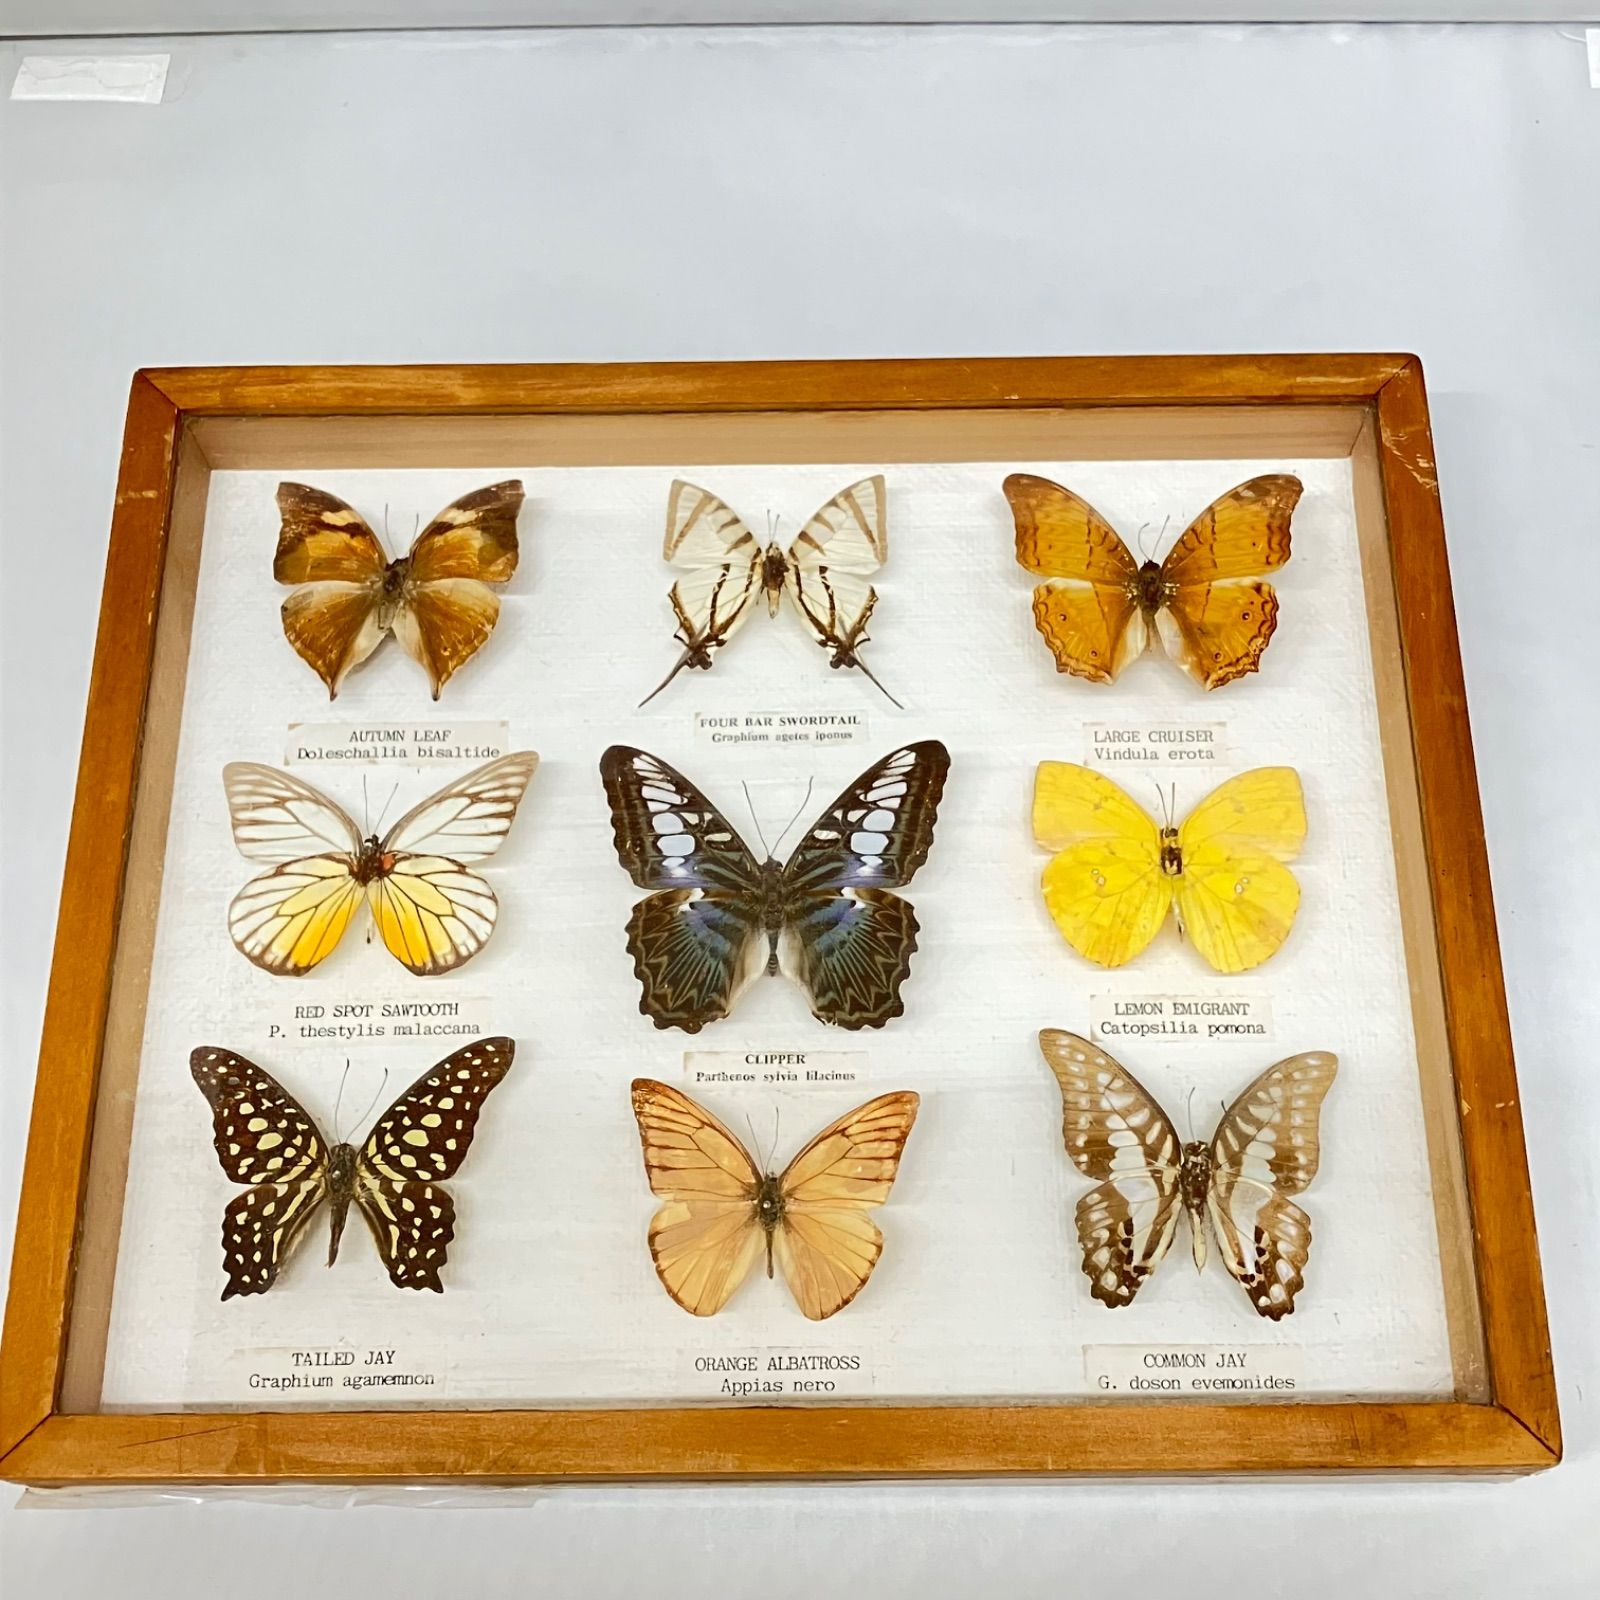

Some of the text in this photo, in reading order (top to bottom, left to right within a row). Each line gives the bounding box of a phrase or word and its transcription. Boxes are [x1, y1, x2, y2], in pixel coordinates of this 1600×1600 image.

[700, 715, 861, 728] FOUR BAR SWORDTAIL
[349, 730, 451, 742] AUTUMN LEAF
[712, 732, 769, 743] Graphium
[815, 730, 852, 741] iponus
[1094, 730, 1214, 743] LARGE CRUISER
[297, 746, 500, 760] Doleschallia bisaltide
[1094, 747, 1215, 760] Vindula erota
[294, 1002, 459, 1019] RED SPOT SAWTOOTH
[1114, 1002, 1250, 1016] LEMON EMIGRANT
[268, 1023, 481, 1039] P. thestylis malaccana
[1100, 1020, 1266, 1037] Catopsilia pomona
[745, 1054, 806, 1065] CLIPPER
[696, 1070, 856, 1083] Parthenos sylvia lilacinus
[291, 1350, 396, 1367] TAILED JAY
[695, 1355, 860, 1371] ORANGE ALBATROSS
[1143, 1352, 1247, 1368] COMMON JAY
[249, 1373, 435, 1391] Graphium agamemnon
[721, 1378, 836, 1396] Appias nero
[1097, 1374, 1295, 1390] G. doson evemonides
